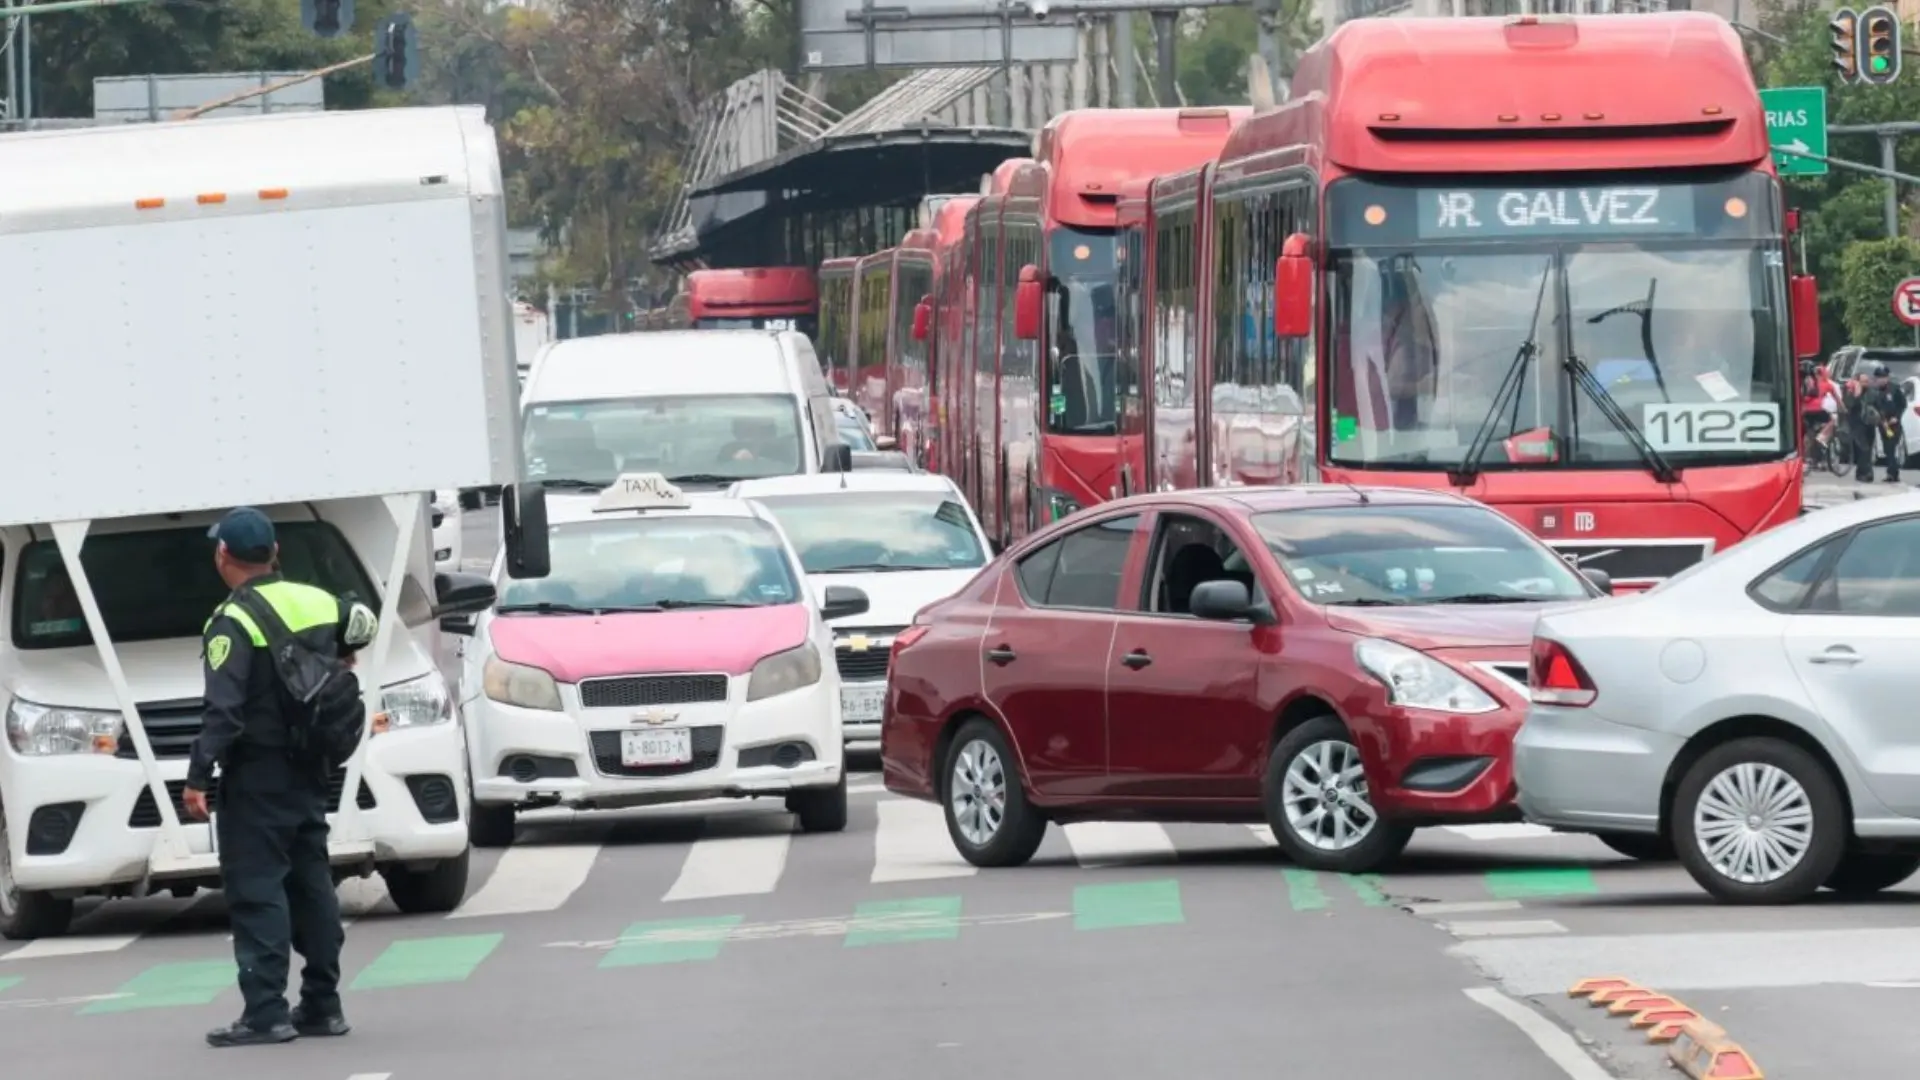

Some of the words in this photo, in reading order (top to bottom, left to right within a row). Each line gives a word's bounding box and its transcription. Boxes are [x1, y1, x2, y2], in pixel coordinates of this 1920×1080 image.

[1497, 189, 1660, 226] GALVEZ
[1650, 409, 1776, 444] 1122
[622, 478, 658, 494] TAXI
